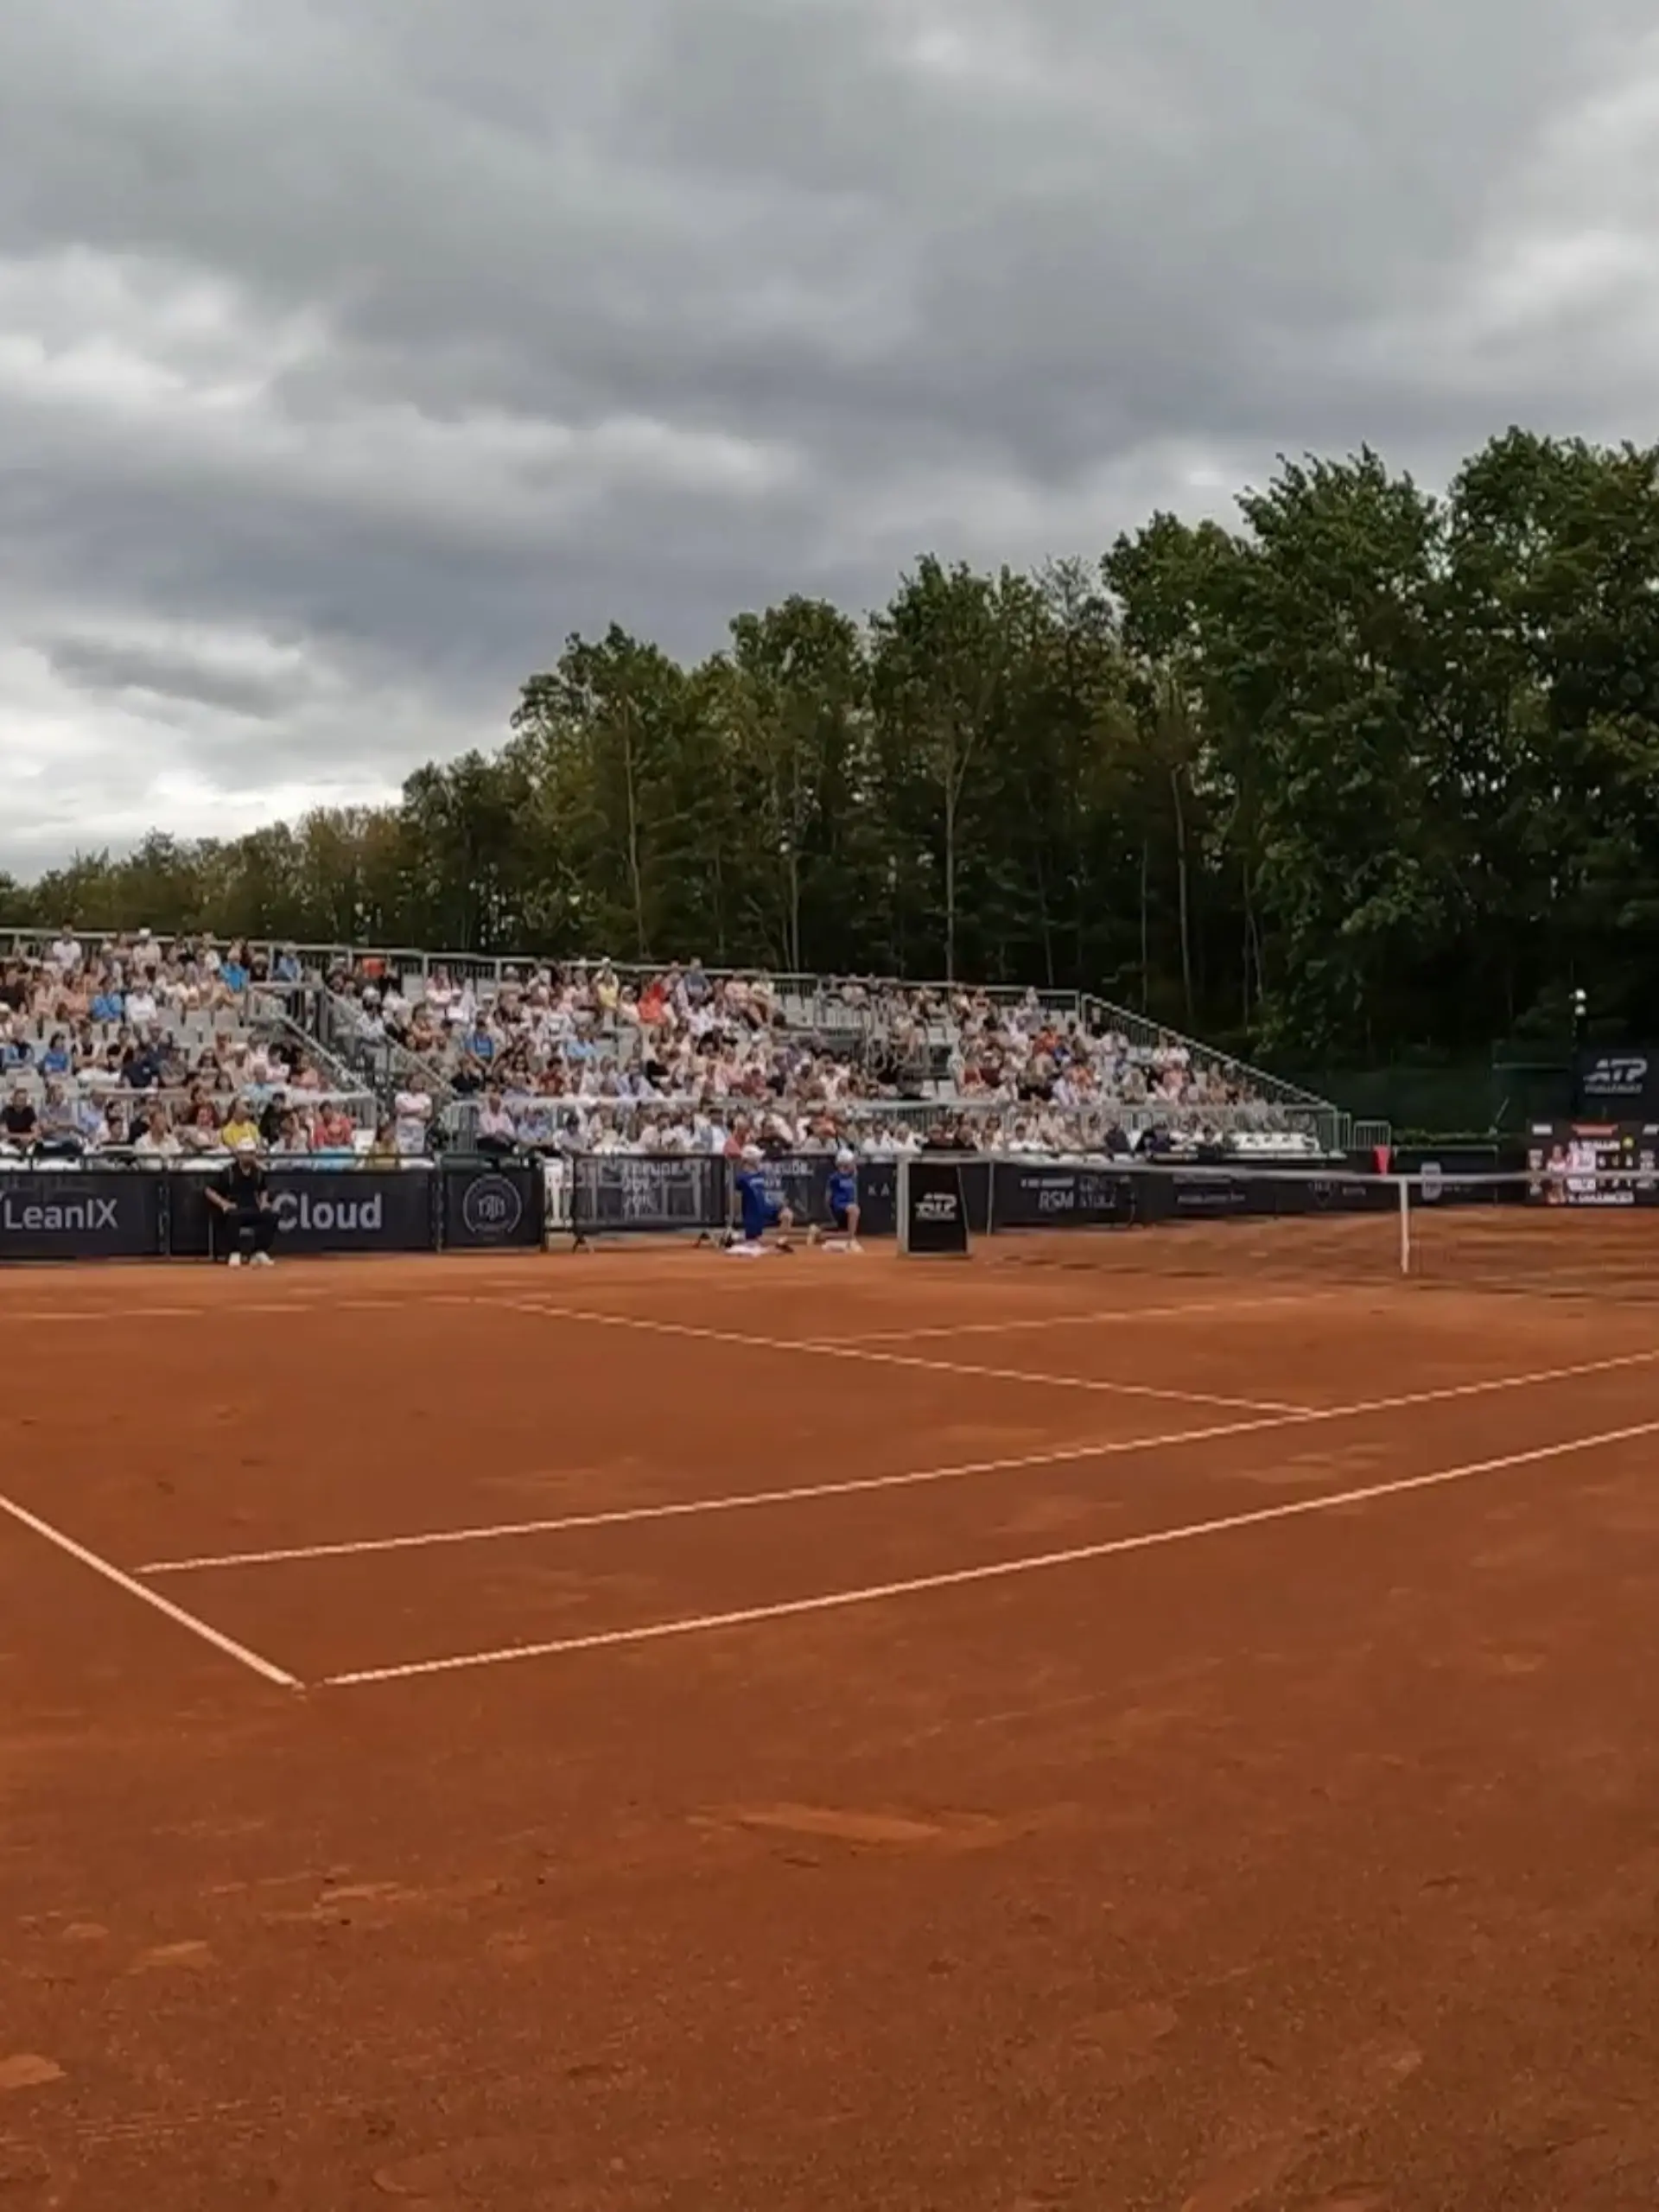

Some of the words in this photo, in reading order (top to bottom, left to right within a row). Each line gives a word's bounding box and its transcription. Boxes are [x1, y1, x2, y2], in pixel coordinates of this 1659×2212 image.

[1583, 1058, 1648, 1082] ATP
[4, 1198, 118, 1230] LeanIX
[271, 1192, 382, 1230] Cloud
